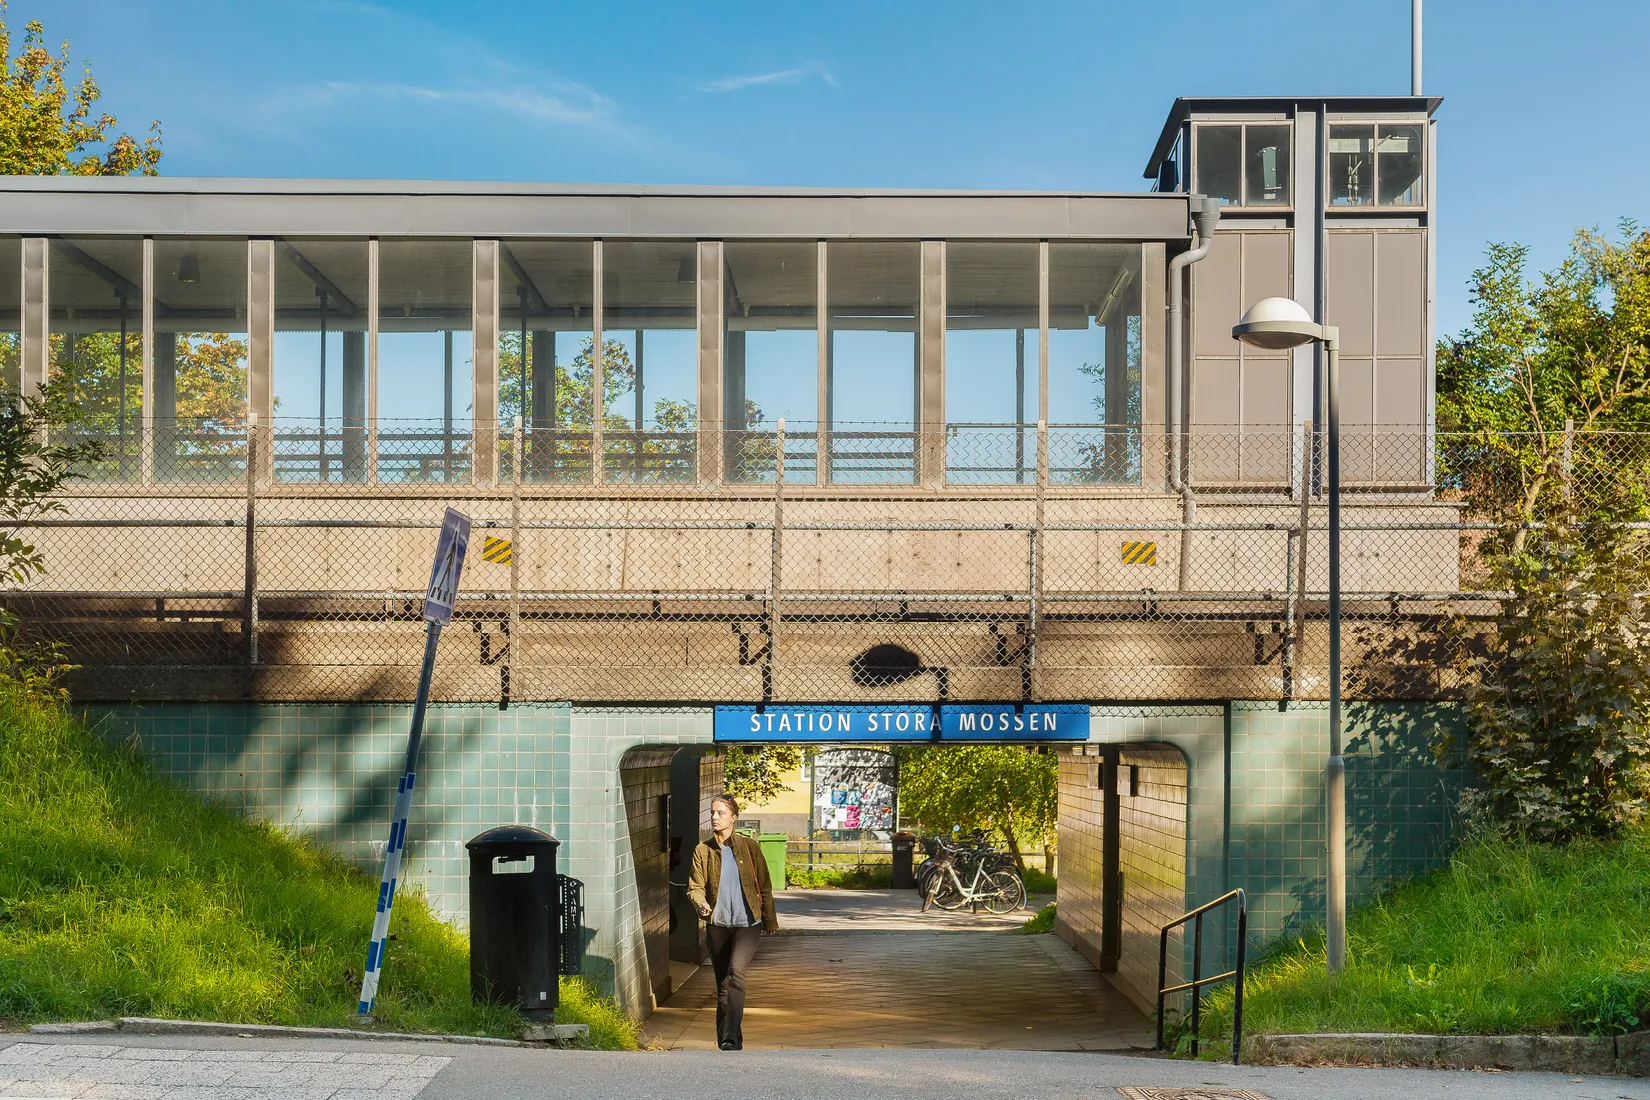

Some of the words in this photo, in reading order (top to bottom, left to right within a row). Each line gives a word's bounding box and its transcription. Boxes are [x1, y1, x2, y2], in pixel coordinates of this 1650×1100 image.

[750, 713, 851, 732] STATION
[868, 712, 943, 732] STORA
[959, 712, 1057, 731] MOSSEN
